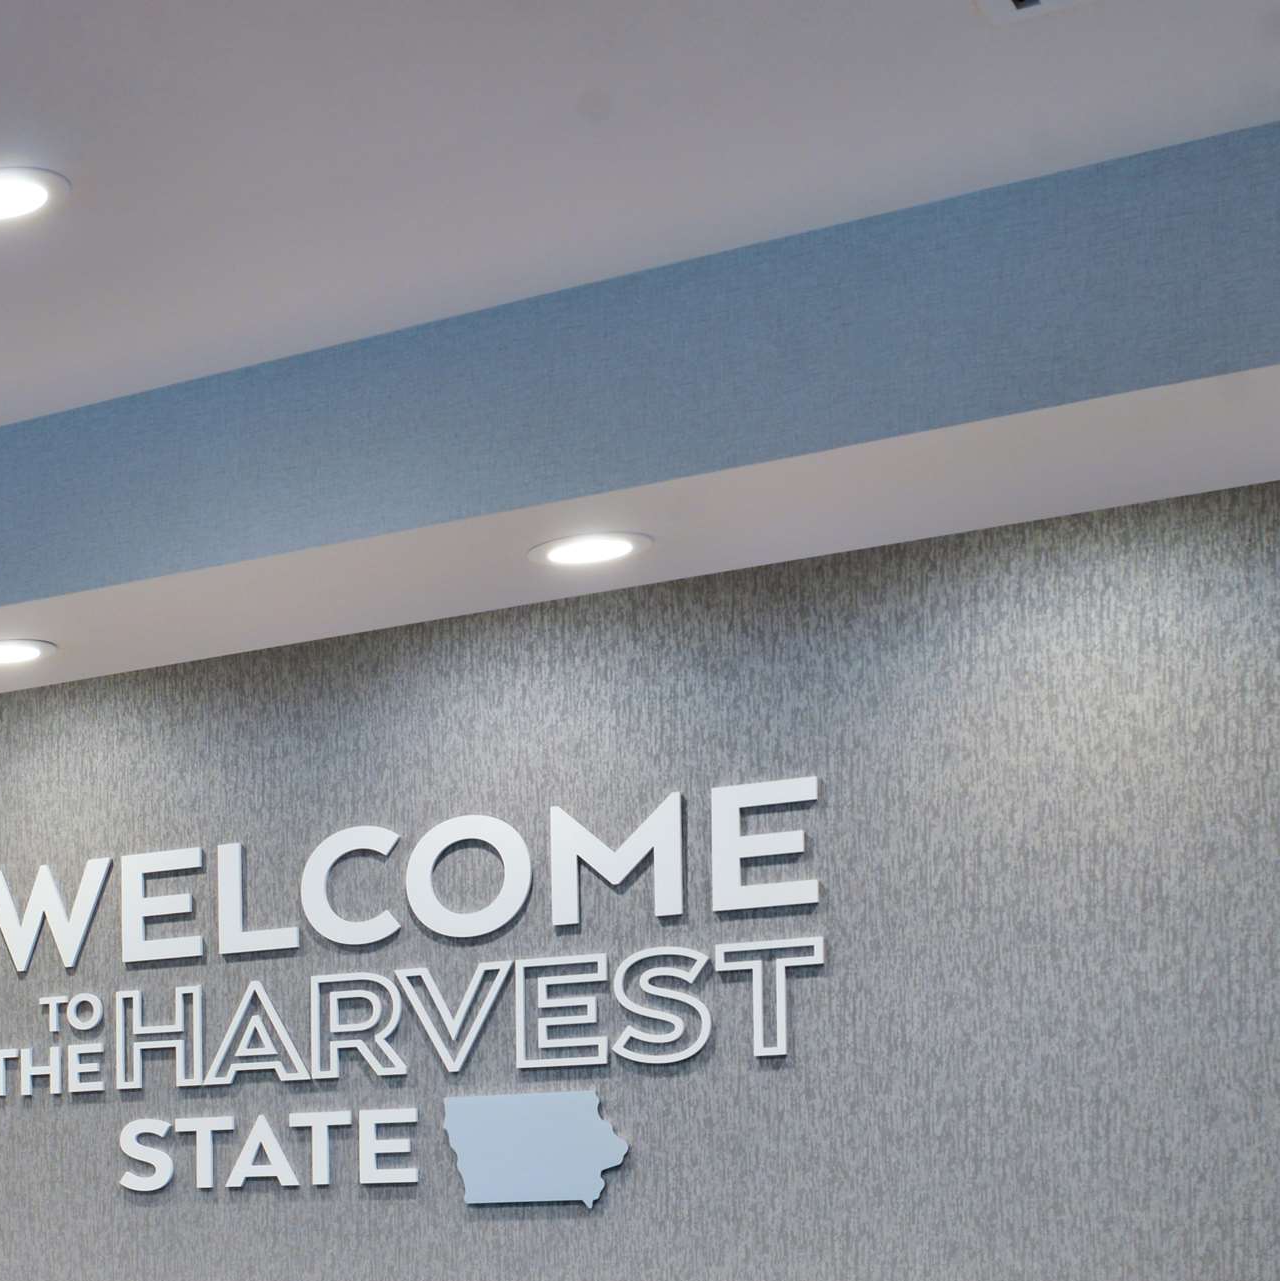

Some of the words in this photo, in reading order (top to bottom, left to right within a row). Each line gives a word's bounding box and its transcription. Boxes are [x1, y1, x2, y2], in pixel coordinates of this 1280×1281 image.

[39, 991, 103, 1034] TO
[114, 936, 825, 1091] HARVEST
[119, 1106, 419, 1192] STATE
